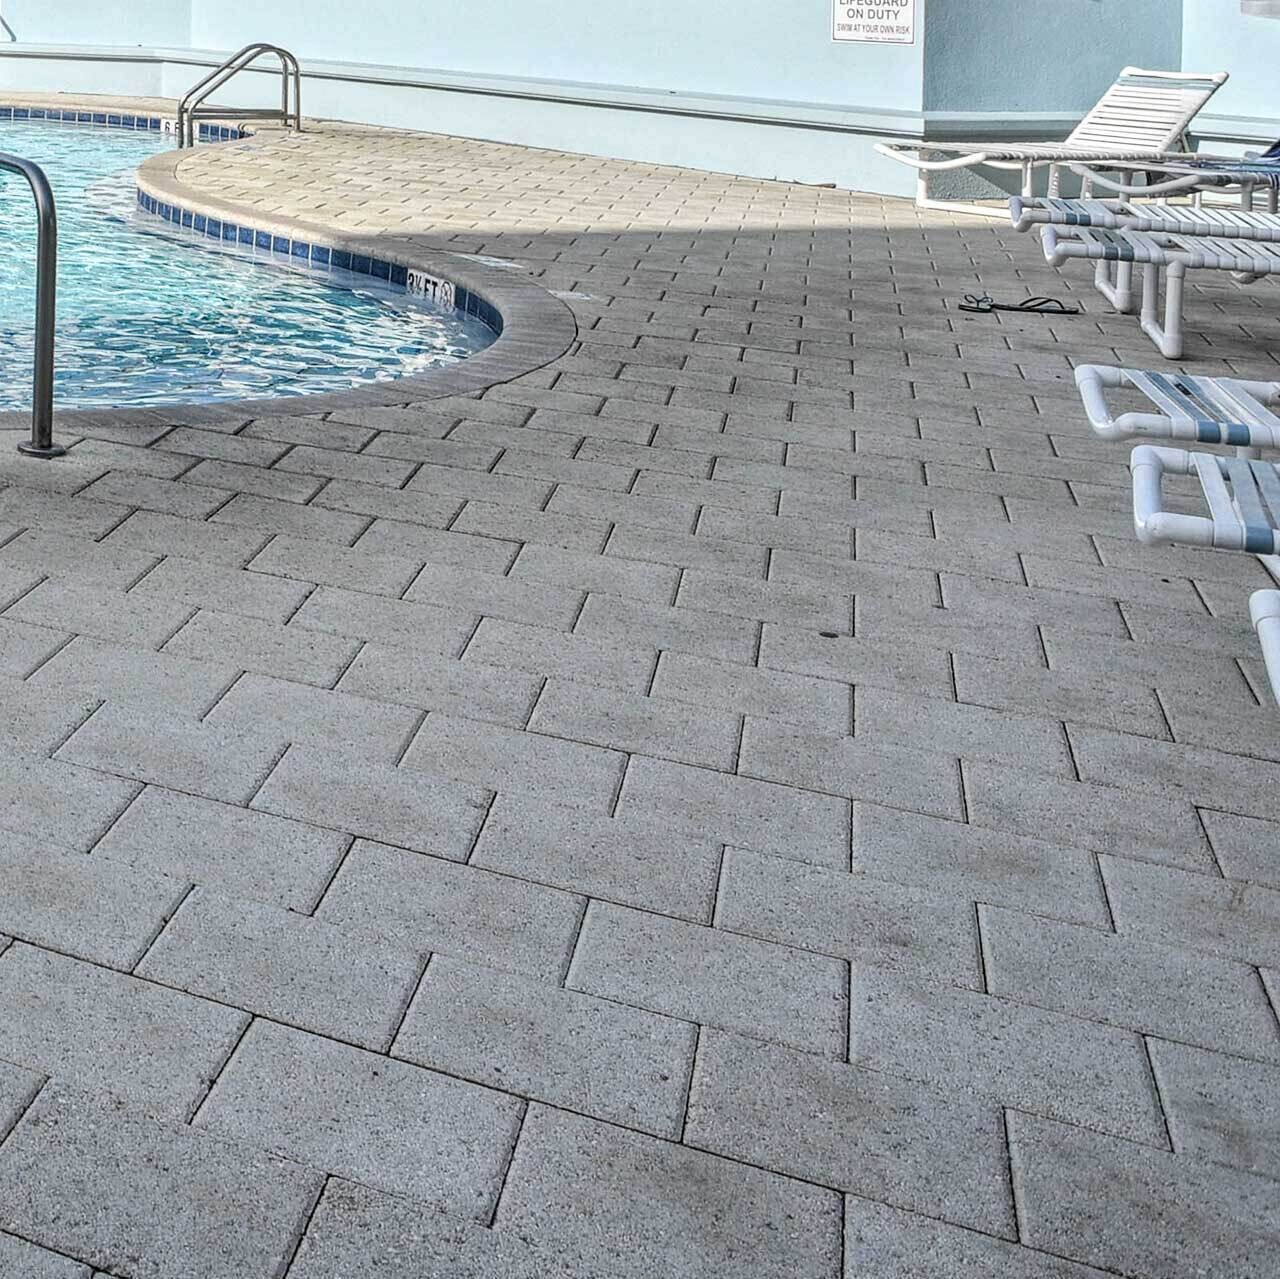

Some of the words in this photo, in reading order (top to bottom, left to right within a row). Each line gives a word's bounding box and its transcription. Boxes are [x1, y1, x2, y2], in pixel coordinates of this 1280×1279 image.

[846, 8, 863, 19] ON
[868, 8, 900, 20] DUTY
[837, 23, 852, 32] SWIM
[853, 24, 860, 32] AT
[862, 24, 879, 33] YOUR
[880, 25, 894, 34] OWN
[895, 25, 910, 35] RISK
[424, 278, 438, 302] FT
